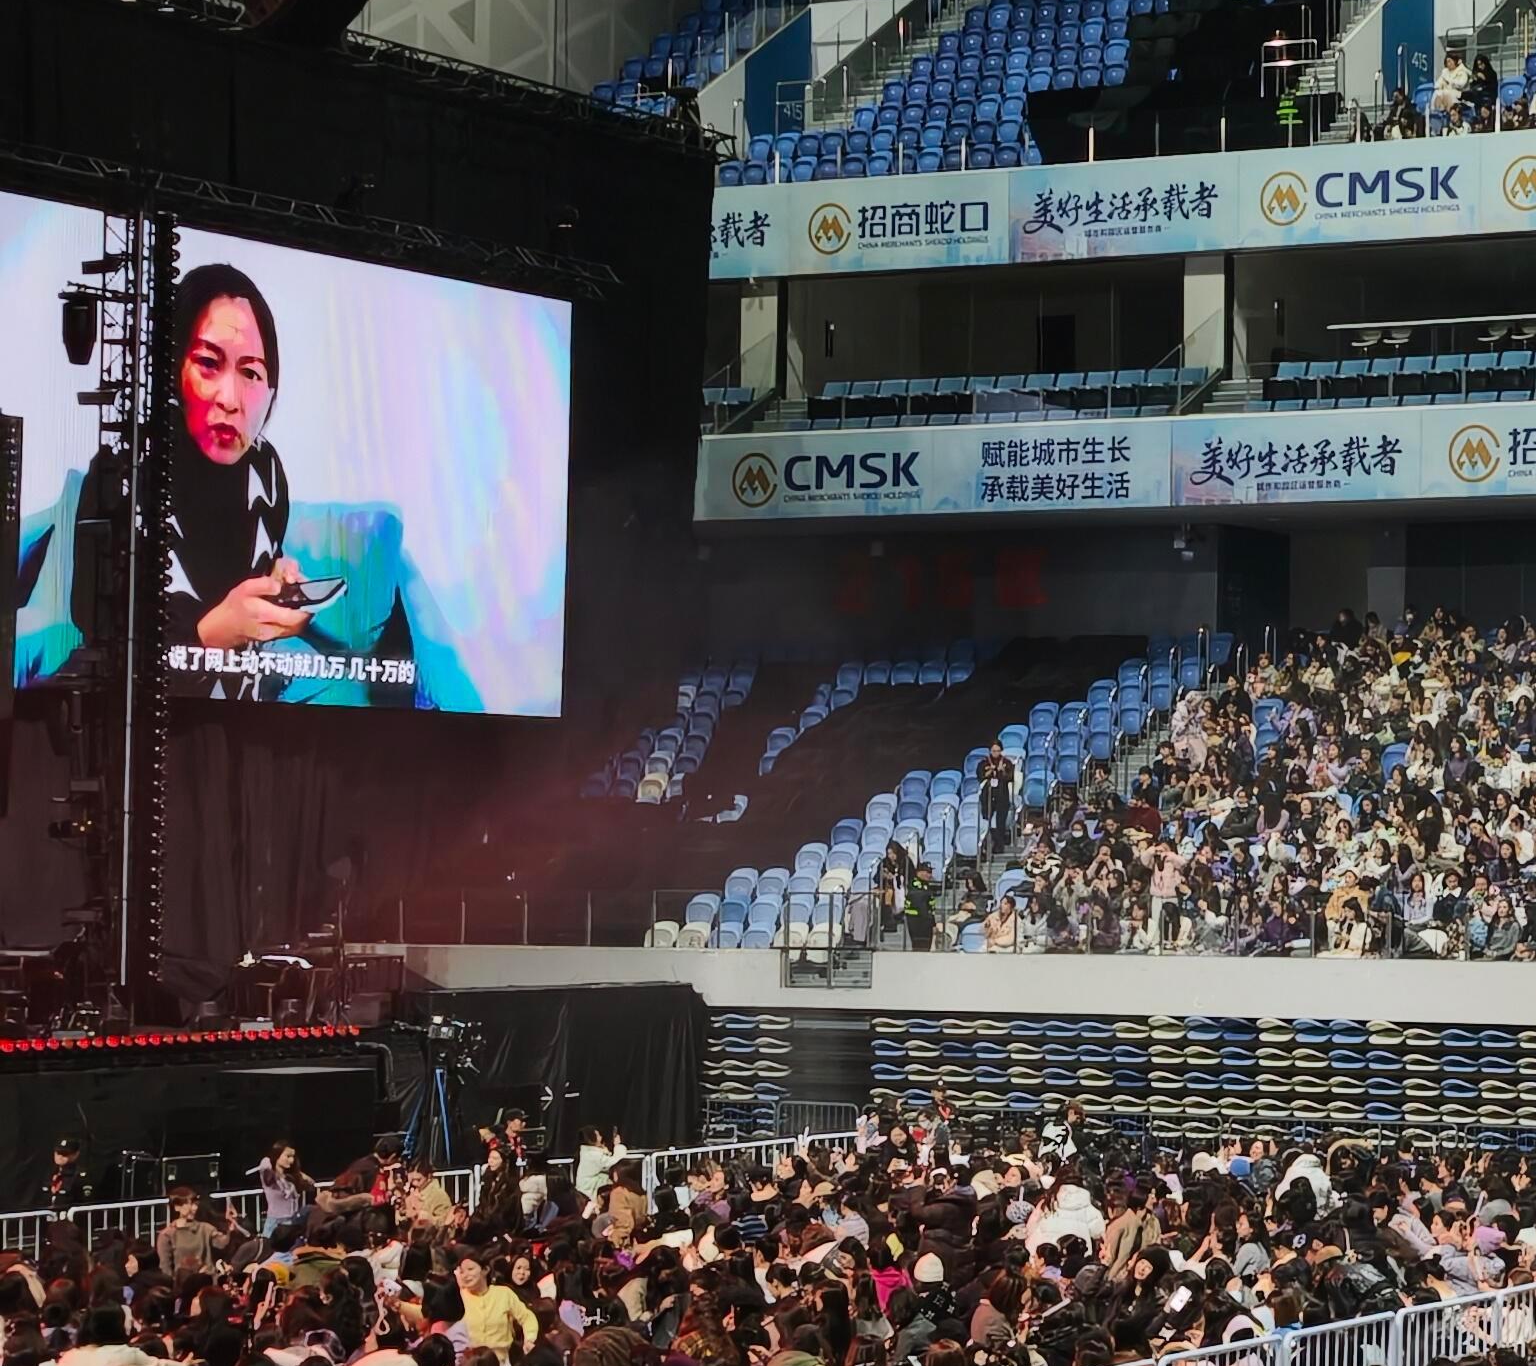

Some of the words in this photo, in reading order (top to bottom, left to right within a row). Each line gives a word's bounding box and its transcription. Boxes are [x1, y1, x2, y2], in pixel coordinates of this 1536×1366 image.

[1314, 164, 1460, 209] CMSK
[857, 200, 989, 239] 招商蛇口
[1022, 180, 1219, 235] 美好生活承载者
[784, 450, 921, 492] CMSK
[980, 436, 1132, 469] 赋能城市生长
[1189, 434, 1404, 486] 美好生活承载者
[980, 471, 1131, 502] 承载美好生活
[168, 644, 346, 680] 说了网上动不动就几万
[349, 657, 416, 685] 几十万的
